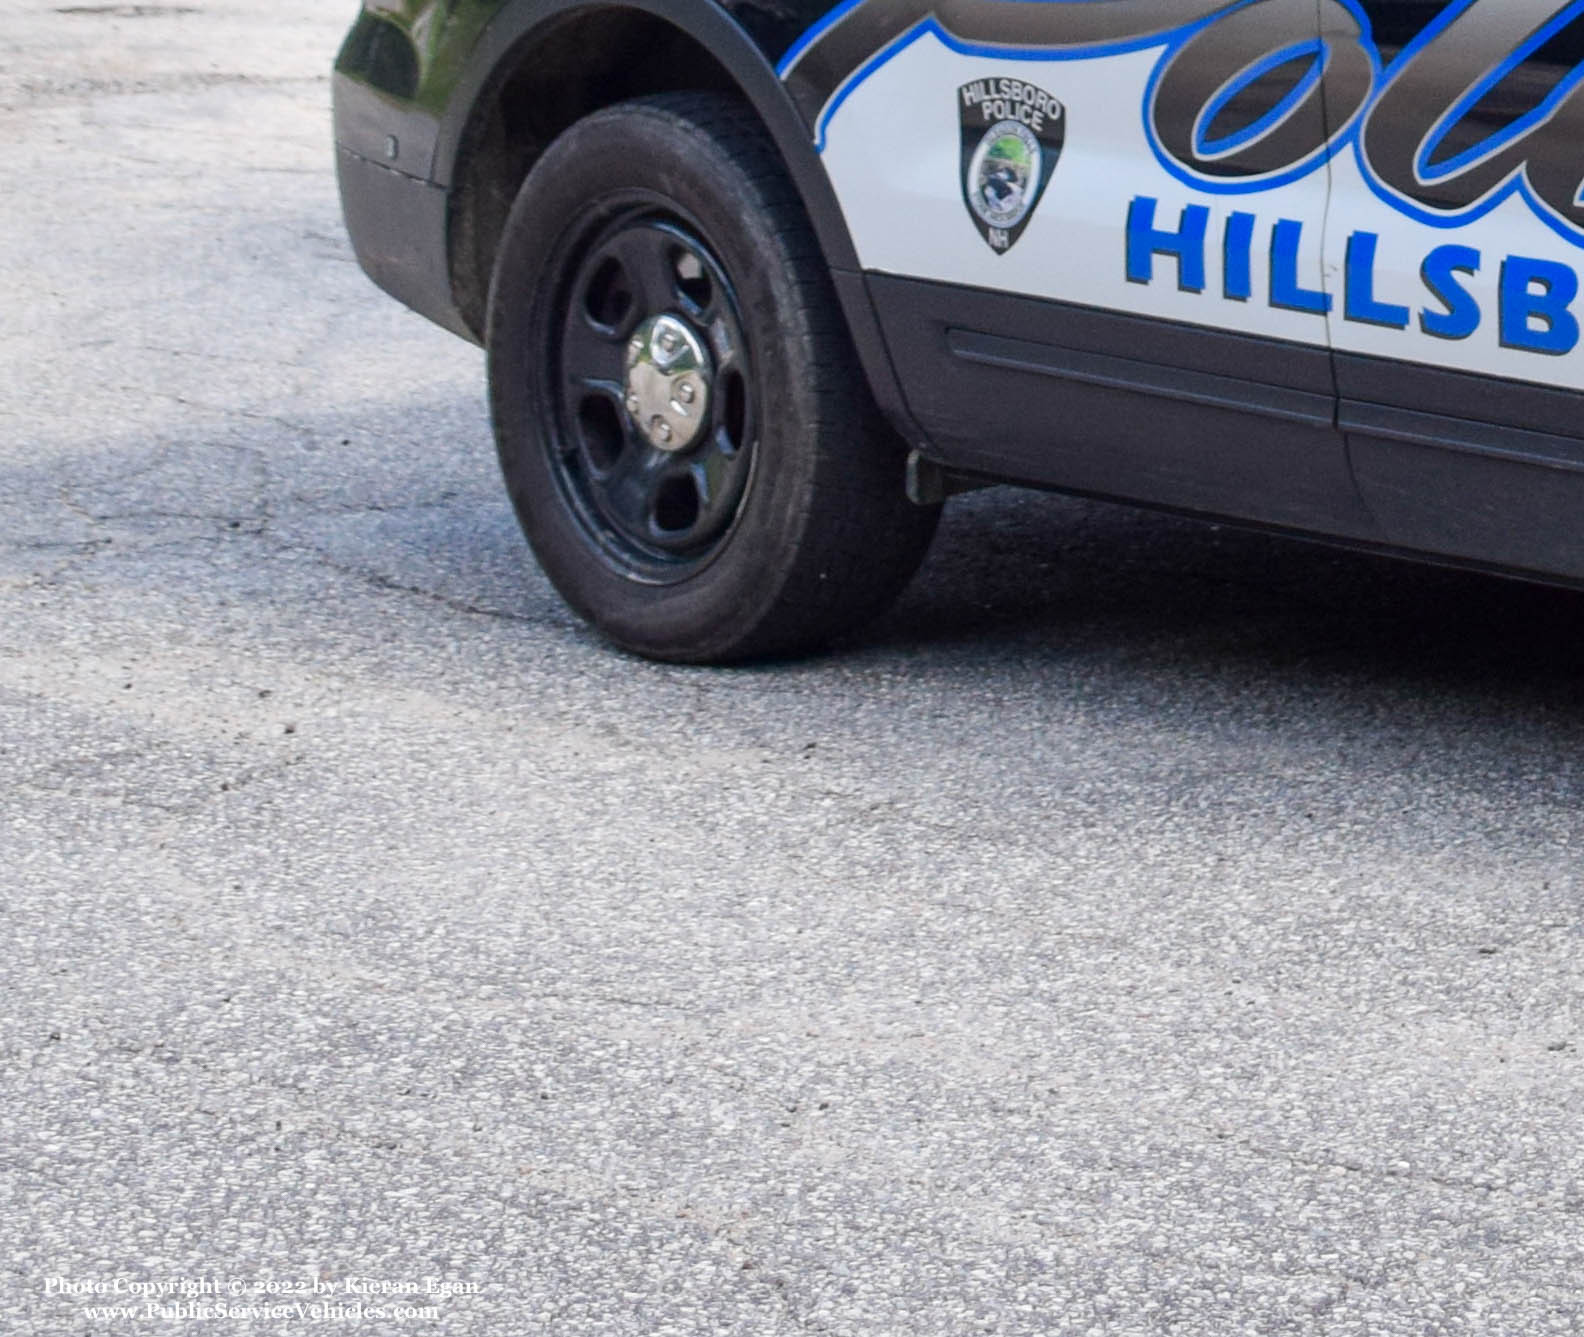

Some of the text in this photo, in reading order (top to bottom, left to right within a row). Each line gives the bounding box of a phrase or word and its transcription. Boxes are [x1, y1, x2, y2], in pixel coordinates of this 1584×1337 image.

[962, 79, 1061, 121] HILLSBORO
[982, 101, 1045, 131] POLICE
[988, 227, 1009, 248] NH
